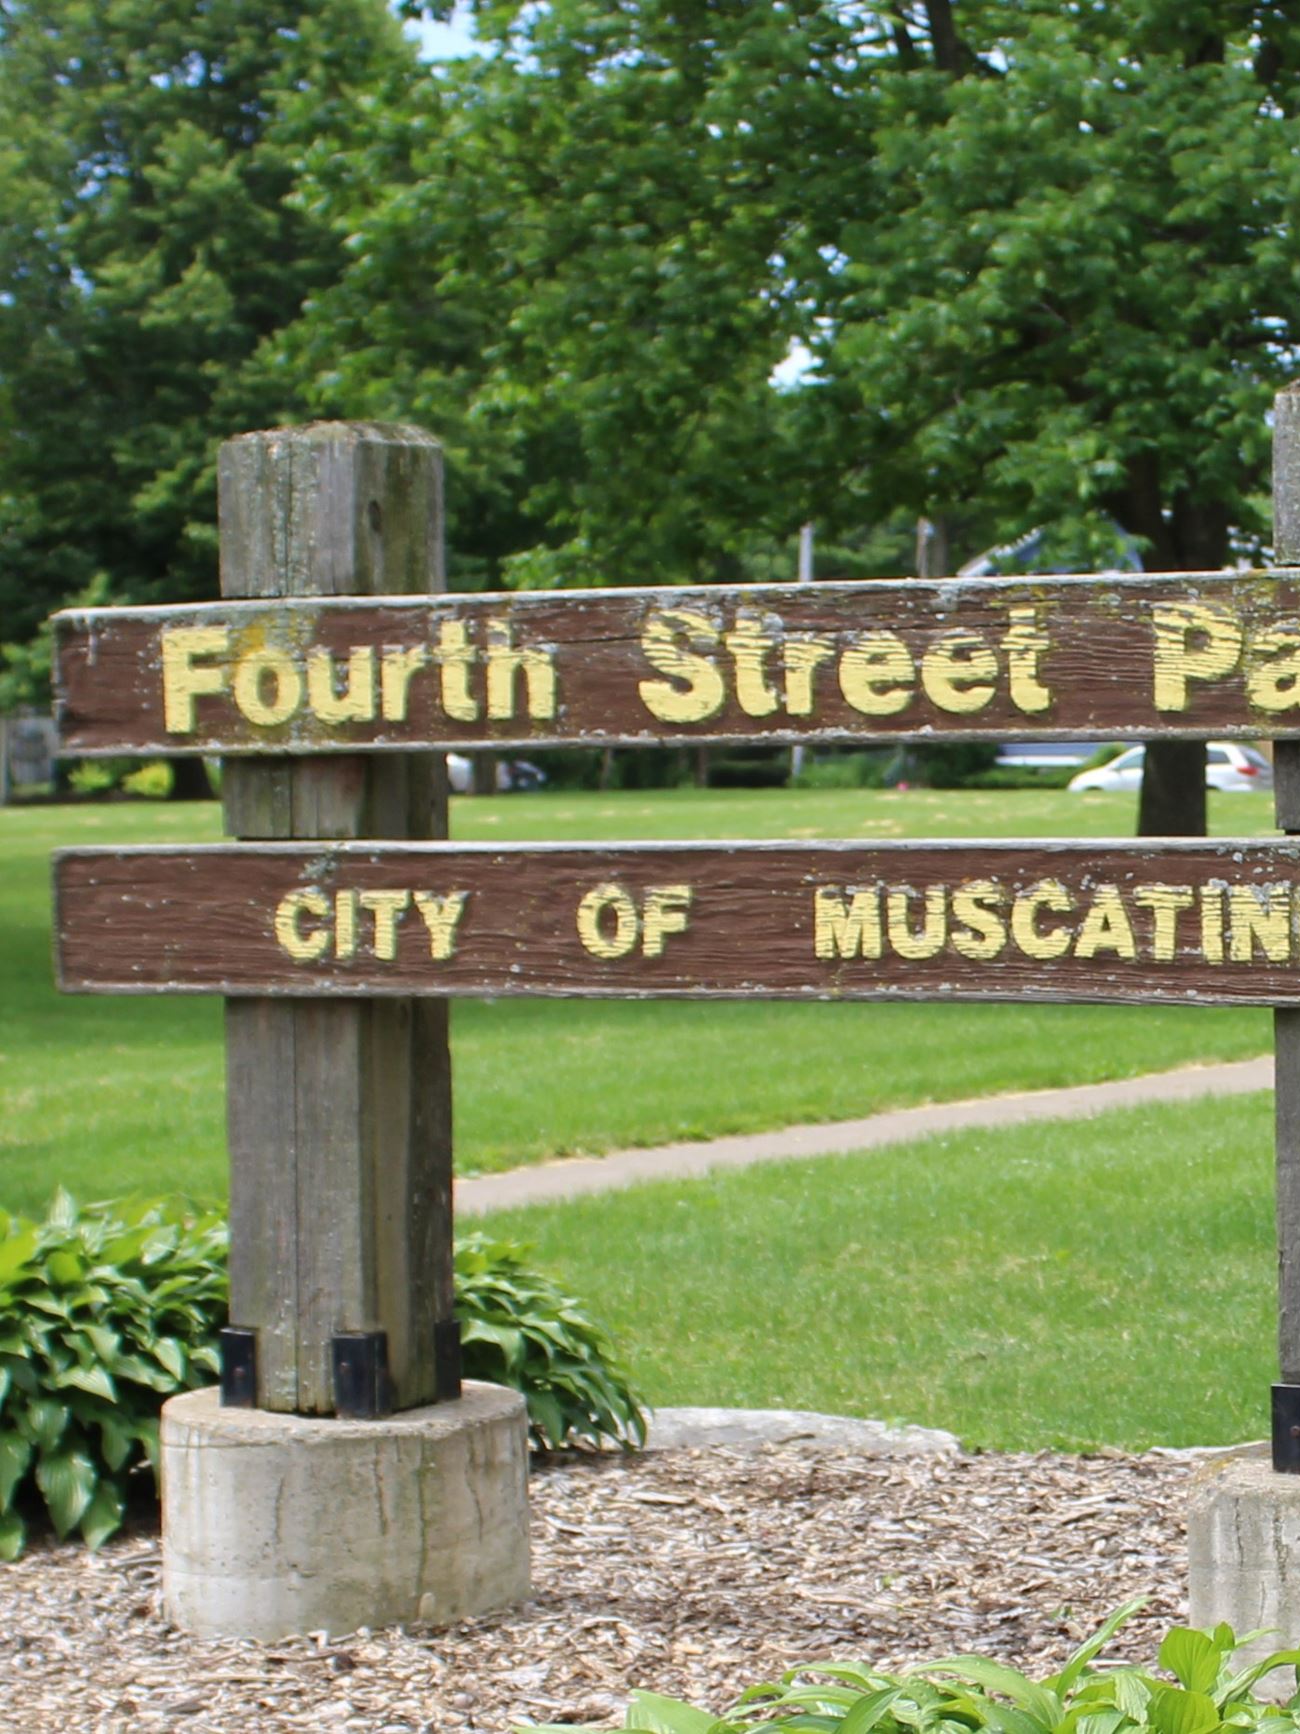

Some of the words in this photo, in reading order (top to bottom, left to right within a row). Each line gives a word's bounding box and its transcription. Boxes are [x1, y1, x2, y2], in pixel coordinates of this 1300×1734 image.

[161, 617, 557, 735] Fourth
[637, 605, 1052, 725] Street
[273, 886, 468, 963] CITY
[576, 882, 694, 962] OF
